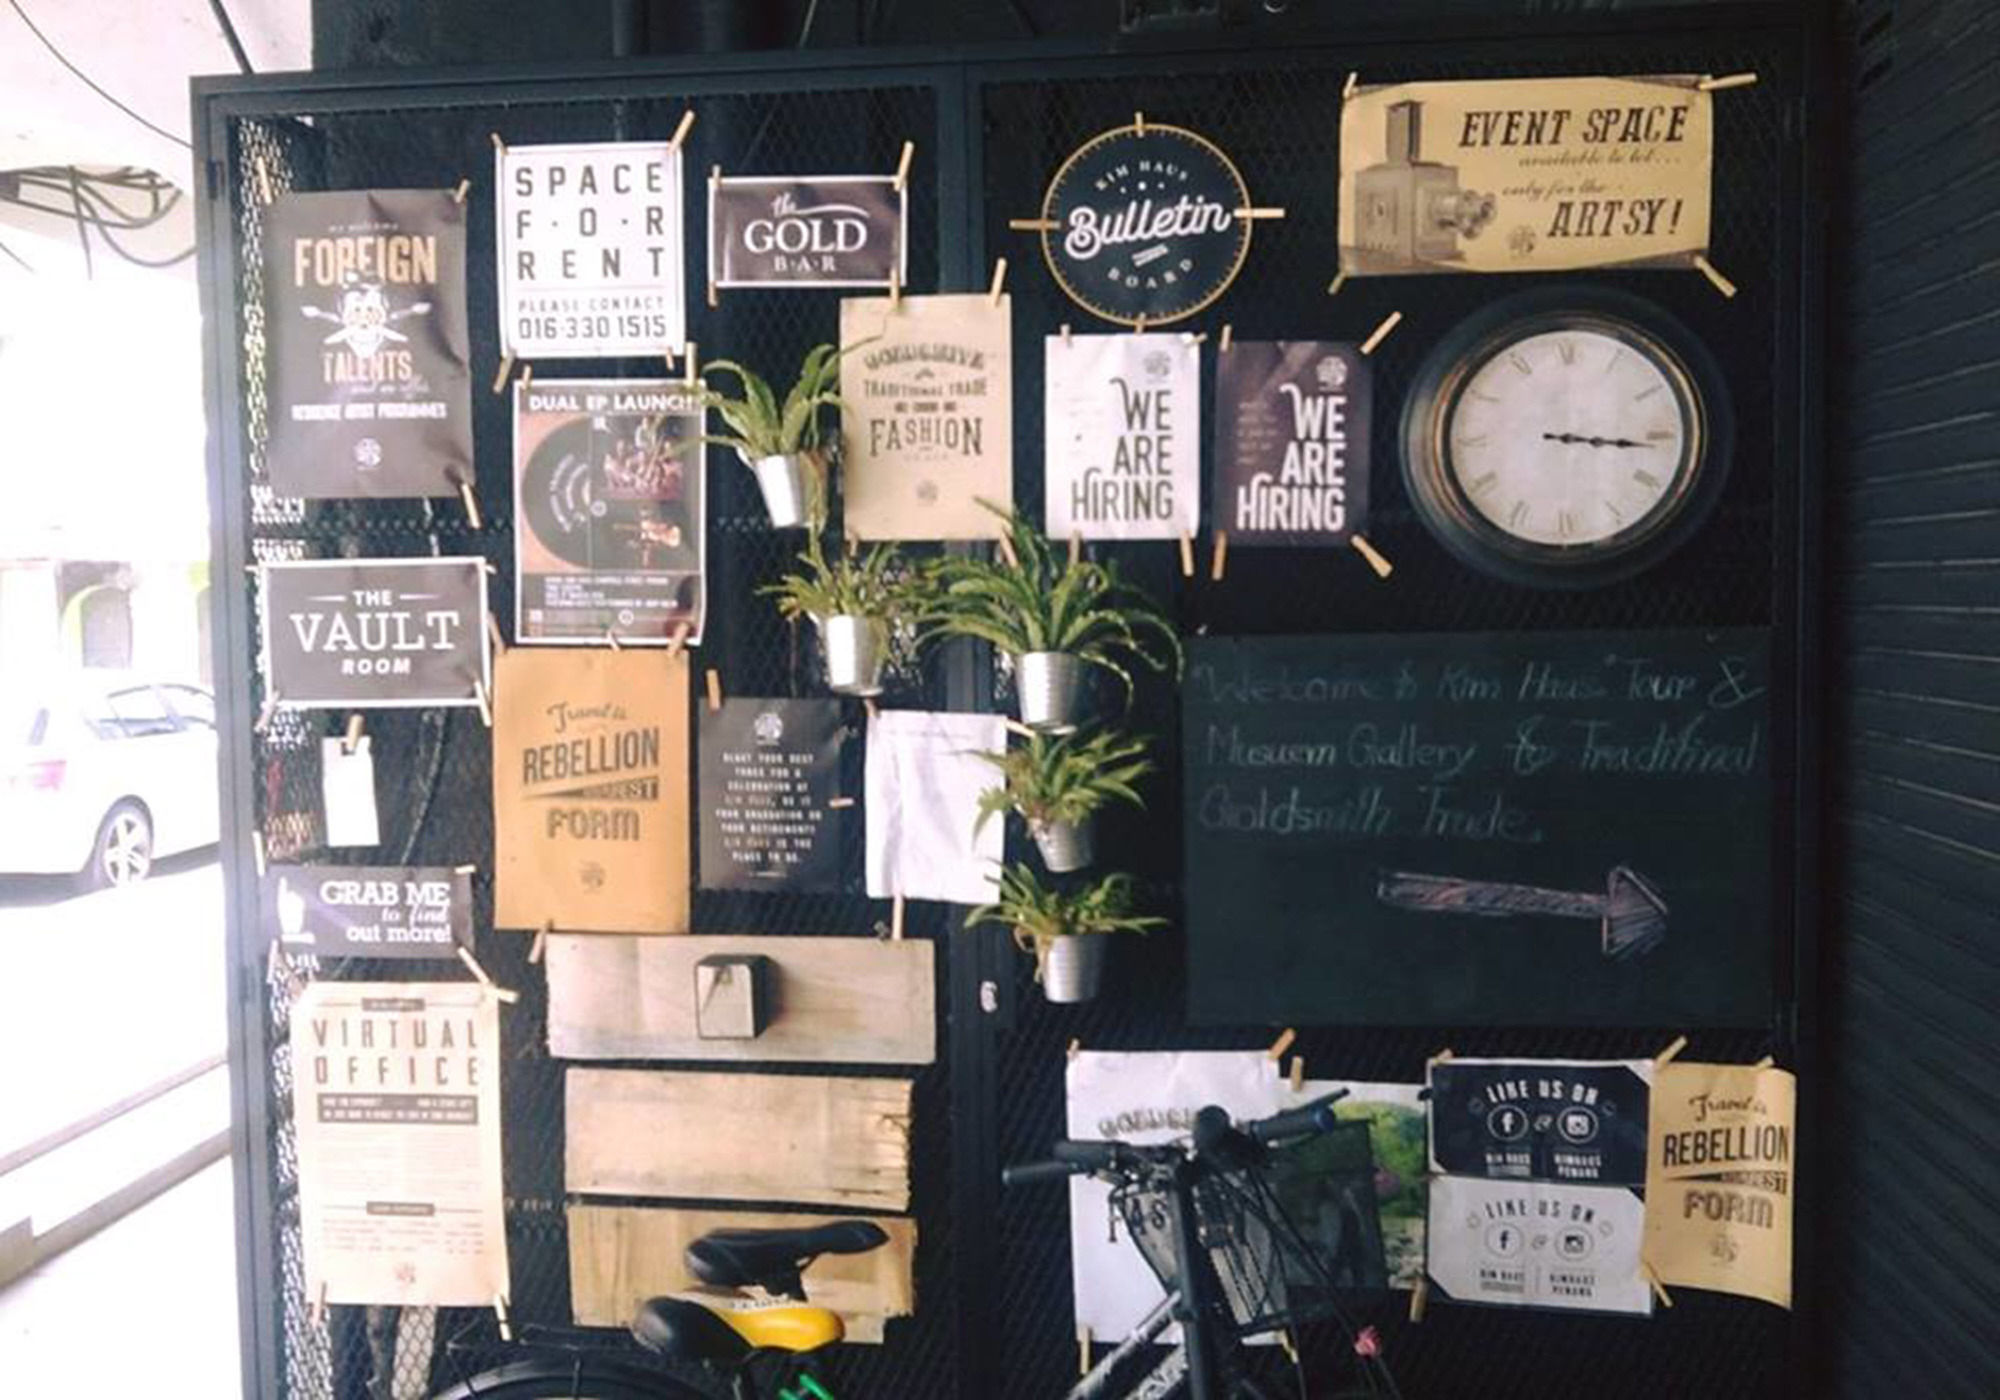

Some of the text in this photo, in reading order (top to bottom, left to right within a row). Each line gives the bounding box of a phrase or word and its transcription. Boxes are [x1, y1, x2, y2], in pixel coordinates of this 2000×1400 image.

[1459, 105, 1689, 147] EVENT SPACE
[515, 162, 663, 197] SPACE
[771, 191, 797, 218] the
[743, 218, 868, 254] GOLD
[1065, 194, 1232, 260] Bulletin
[294, 234, 437, 288] FOREIGN
[517, 246, 665, 281] RENT
[518, 296, 664, 313] PLEASE CONTACT
[617, 314, 666, 338] 1515
[322, 350, 413, 384] TALENTS
[528, 394, 581, 412] DUAL
[1108, 376, 1173, 432] WE
[1278, 382, 1348, 440] WE
[869, 416, 983, 458] FASHION
[1112, 434, 1174, 477] ARE
[1280, 440, 1347, 487] ARE
[1070, 466, 1174, 523] HIRING
[1236, 472, 1346, 532] HIRING
[352, 589, 393, 606] THE
[289, 610, 460, 653] VAULT
[341, 657, 412, 676] ROOM
[1707, 655, 1768, 709] &
[522, 726, 661, 786] REBELLION
[1349, 721, 1477, 781] Gallery
[547, 807, 641, 842] FORM
[319, 880, 451, 906] GRAB ME
[381, 903, 448, 928] to find
[346, 925, 452, 943] out more!
[312, 1018, 477, 1048] VIRTUAL
[314, 1055, 479, 1085] OFFICE
[1486, 1079, 1599, 1106] LIKE US ON
[1662, 1125, 1790, 1169] REBELLION
[1485, 1198, 1528, 1220] LIKE
[1538, 1200, 1561, 1218] US
[1682, 1189, 1774, 1230] FORM
